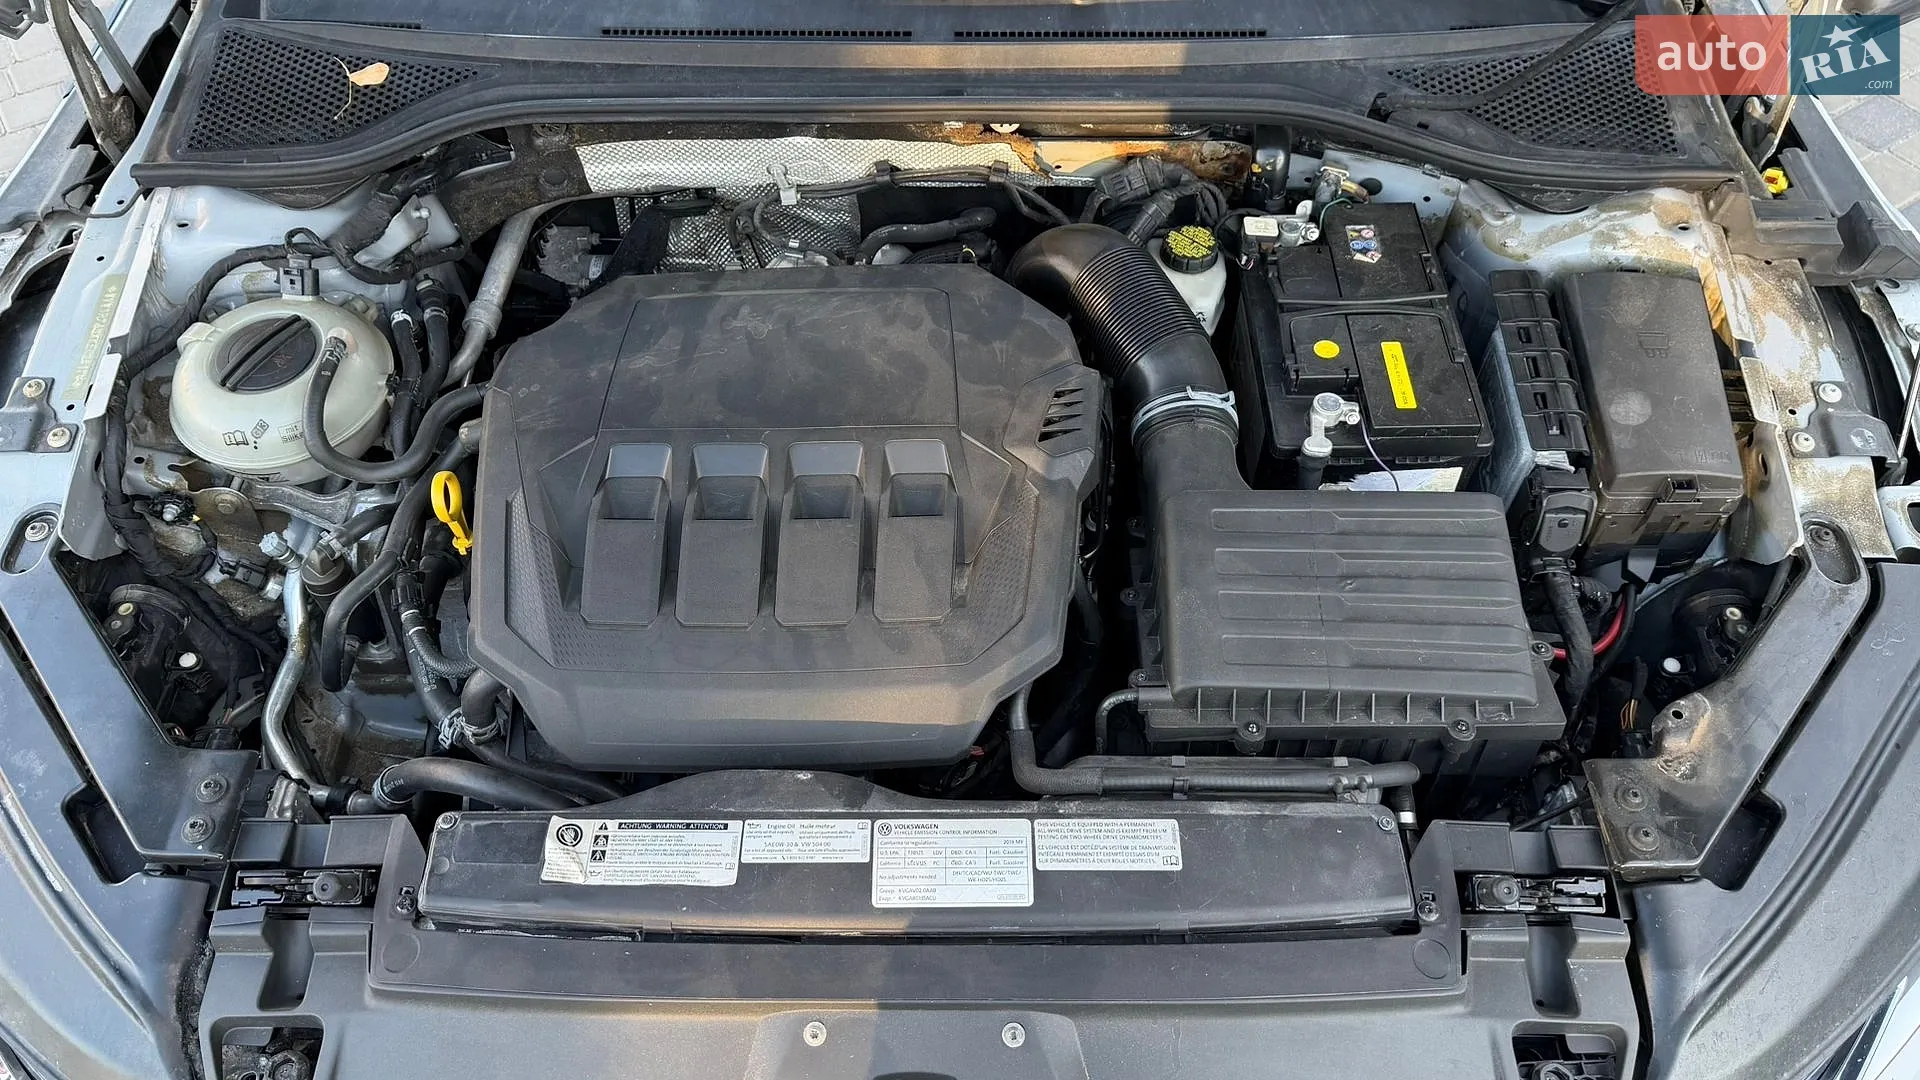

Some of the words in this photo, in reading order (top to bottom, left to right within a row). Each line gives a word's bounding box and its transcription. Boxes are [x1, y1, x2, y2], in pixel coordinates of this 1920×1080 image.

[285, 425, 298, 434] mit
[620, 822, 652, 830] ACHTUNG
[655, 822, 687, 830] WARNING
[689, 822, 724, 830] ATTENTION
